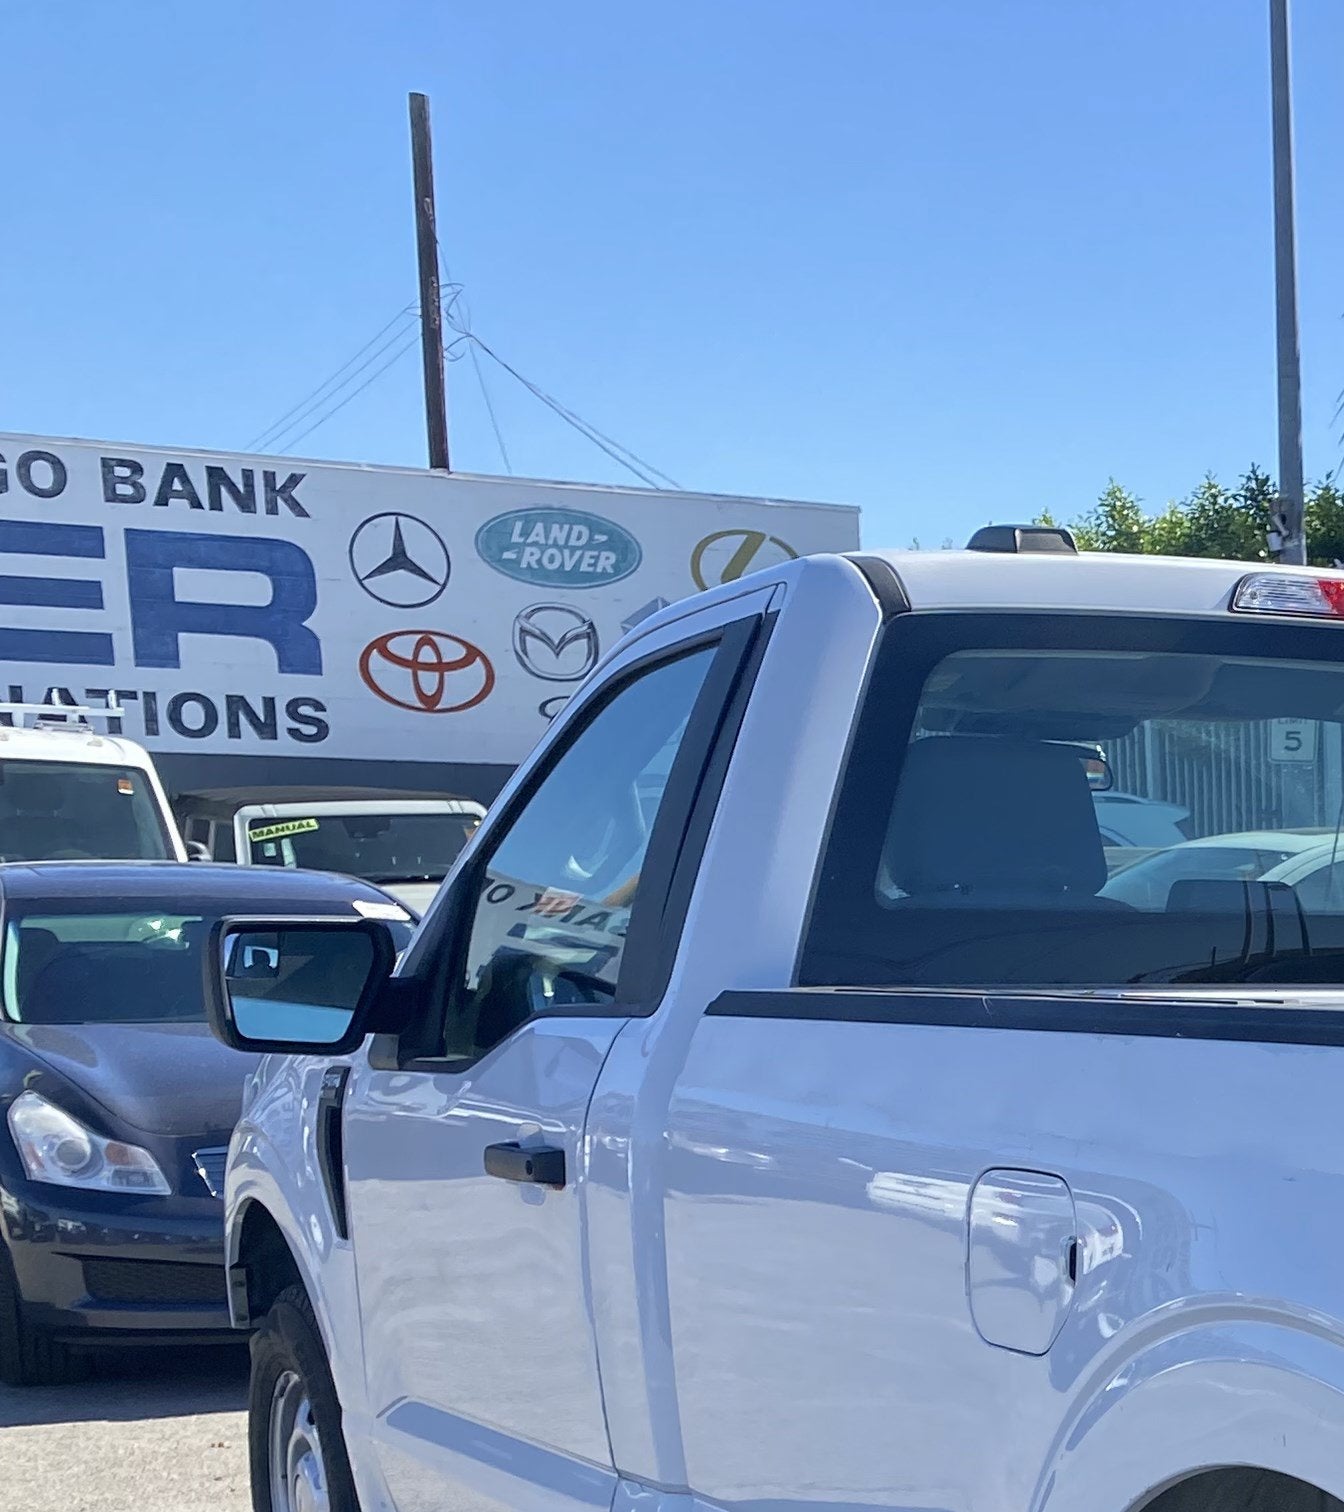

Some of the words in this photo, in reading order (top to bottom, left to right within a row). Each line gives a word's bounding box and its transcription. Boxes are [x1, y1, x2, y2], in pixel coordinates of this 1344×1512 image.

[0, 450, 67, 498] O
[100, 456, 311, 518] BANK
[511, 520, 590, 547] LAND
[519, 546, 617, 573] ROVER
[0, 519, 323, 676] ER
[1284, 731, 1302, 751] 5
[251, 820, 316, 838] MANUAL
